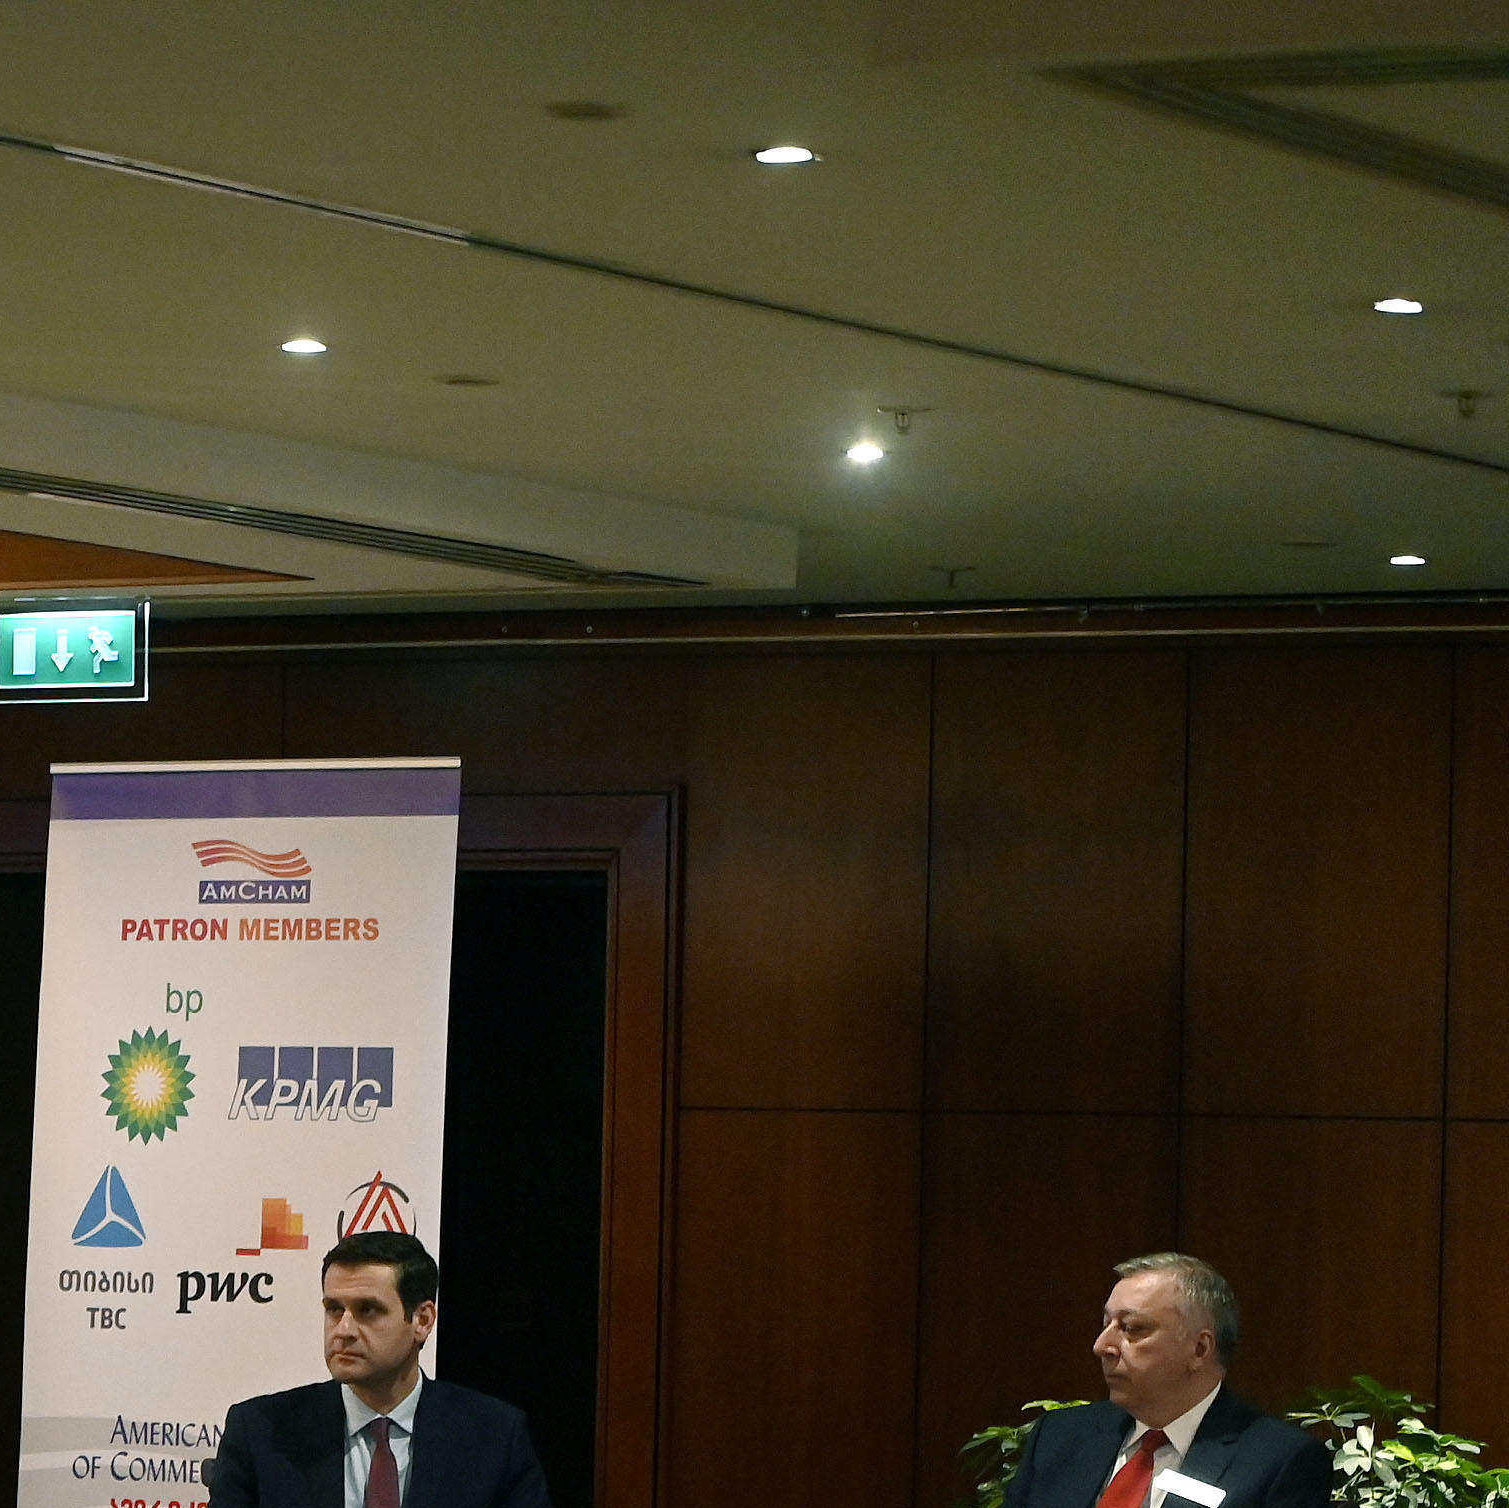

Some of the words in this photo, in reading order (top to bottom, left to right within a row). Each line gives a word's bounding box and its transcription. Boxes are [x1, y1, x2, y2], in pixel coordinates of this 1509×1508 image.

[120, 918, 229, 941] PATRON
[238, 917, 380, 941] MEMBERS
[165, 982, 204, 1021] bp
[227, 1078, 382, 1123] KPMG
[174, 1269, 275, 1314] pwc
[86, 1307, 127, 1330] TBC
[72, 1455, 102, 1480] OF
[110, 1451, 202, 1484] COMME
